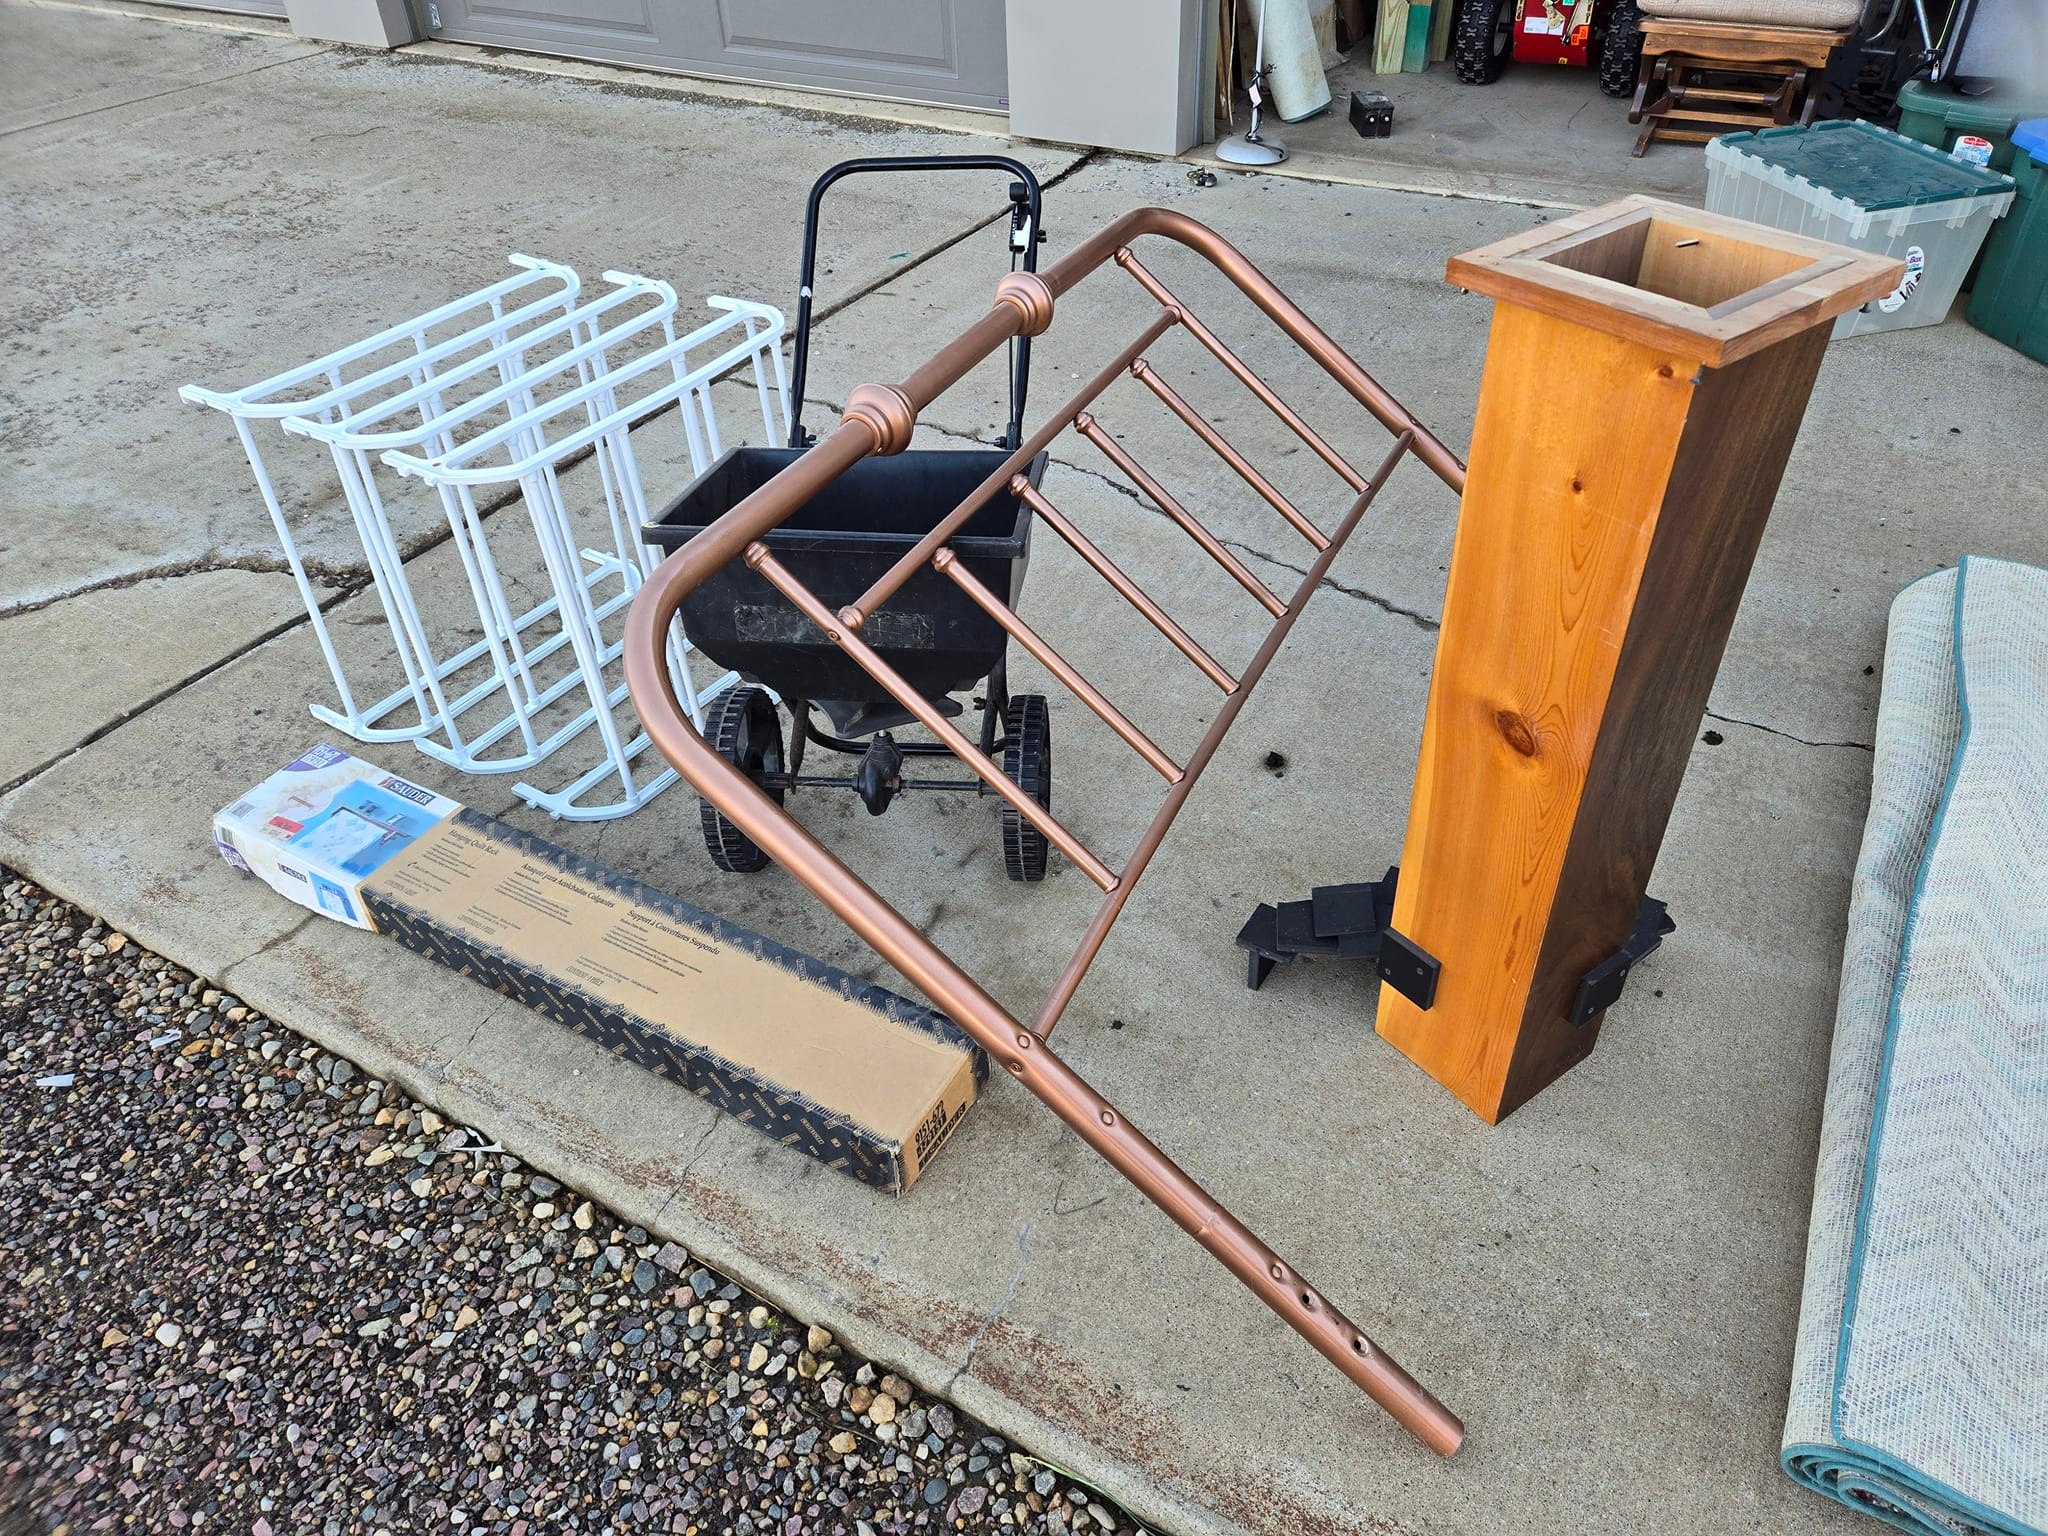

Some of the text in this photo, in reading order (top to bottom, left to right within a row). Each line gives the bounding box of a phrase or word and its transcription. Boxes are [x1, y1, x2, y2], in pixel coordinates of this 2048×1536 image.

[390, 781, 432, 805] SAUDER
[626, 909, 651, 926] Support
[655, 921, 690, 942] Couvertures
[689, 937, 721, 955] Suspendu
